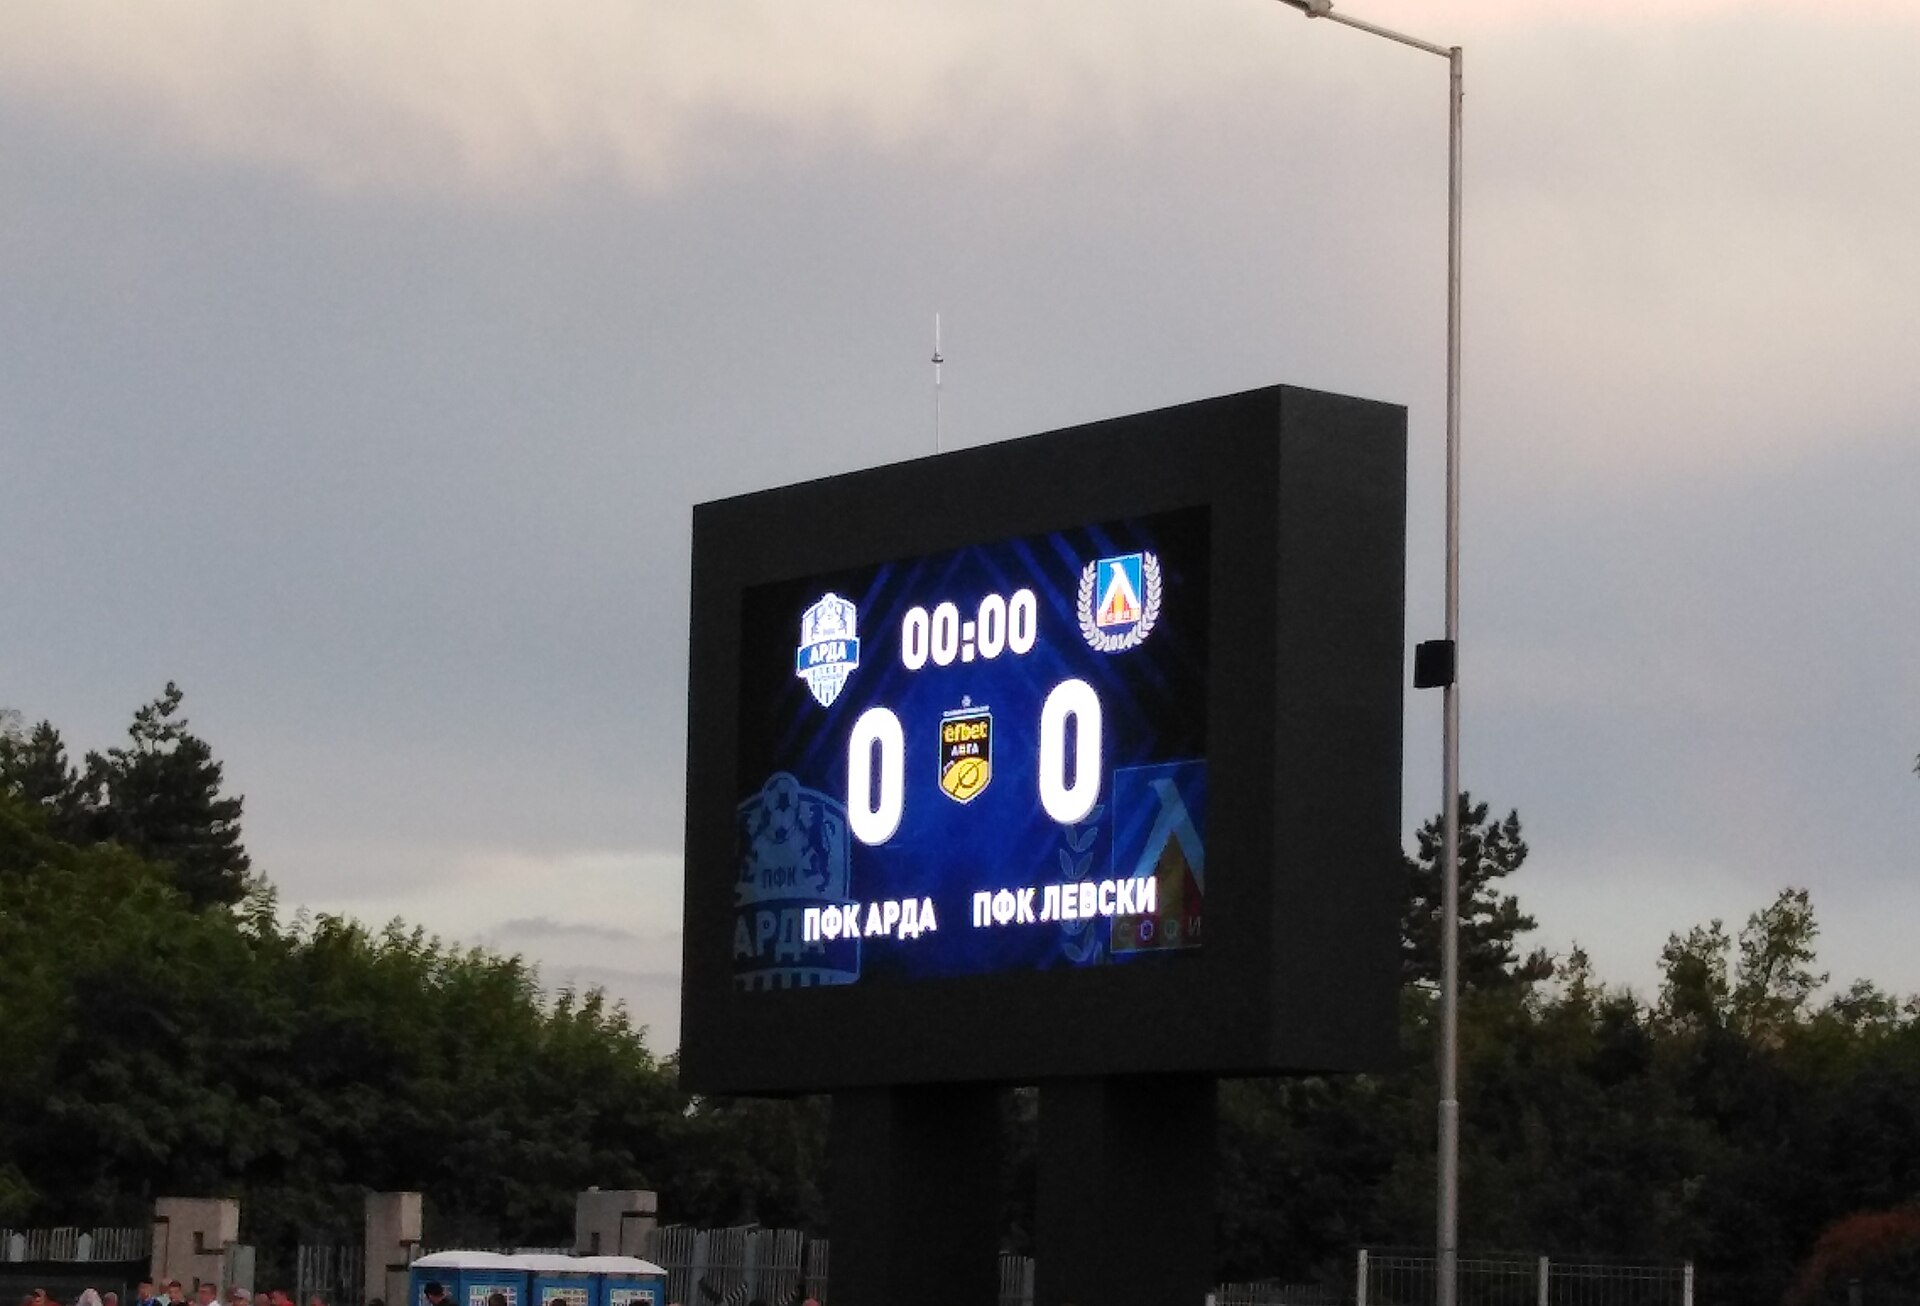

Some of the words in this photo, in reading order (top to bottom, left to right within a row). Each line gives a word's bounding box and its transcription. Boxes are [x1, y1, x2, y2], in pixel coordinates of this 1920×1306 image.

[809, 641, 847, 665] АРДА
[902, 588, 1037, 670] 00:00
[944, 721, 988, 742] efbet
[1040, 679, 1102, 825] 0
[848, 707, 905, 845] 0
[762, 867, 797, 888] ПФК
[972, 887, 1035, 927] ПФК
[1039, 875, 1156, 922] ЛЕВСКИ
[804, 904, 861, 941] ПФК
[864, 896, 937, 940] АРДА
